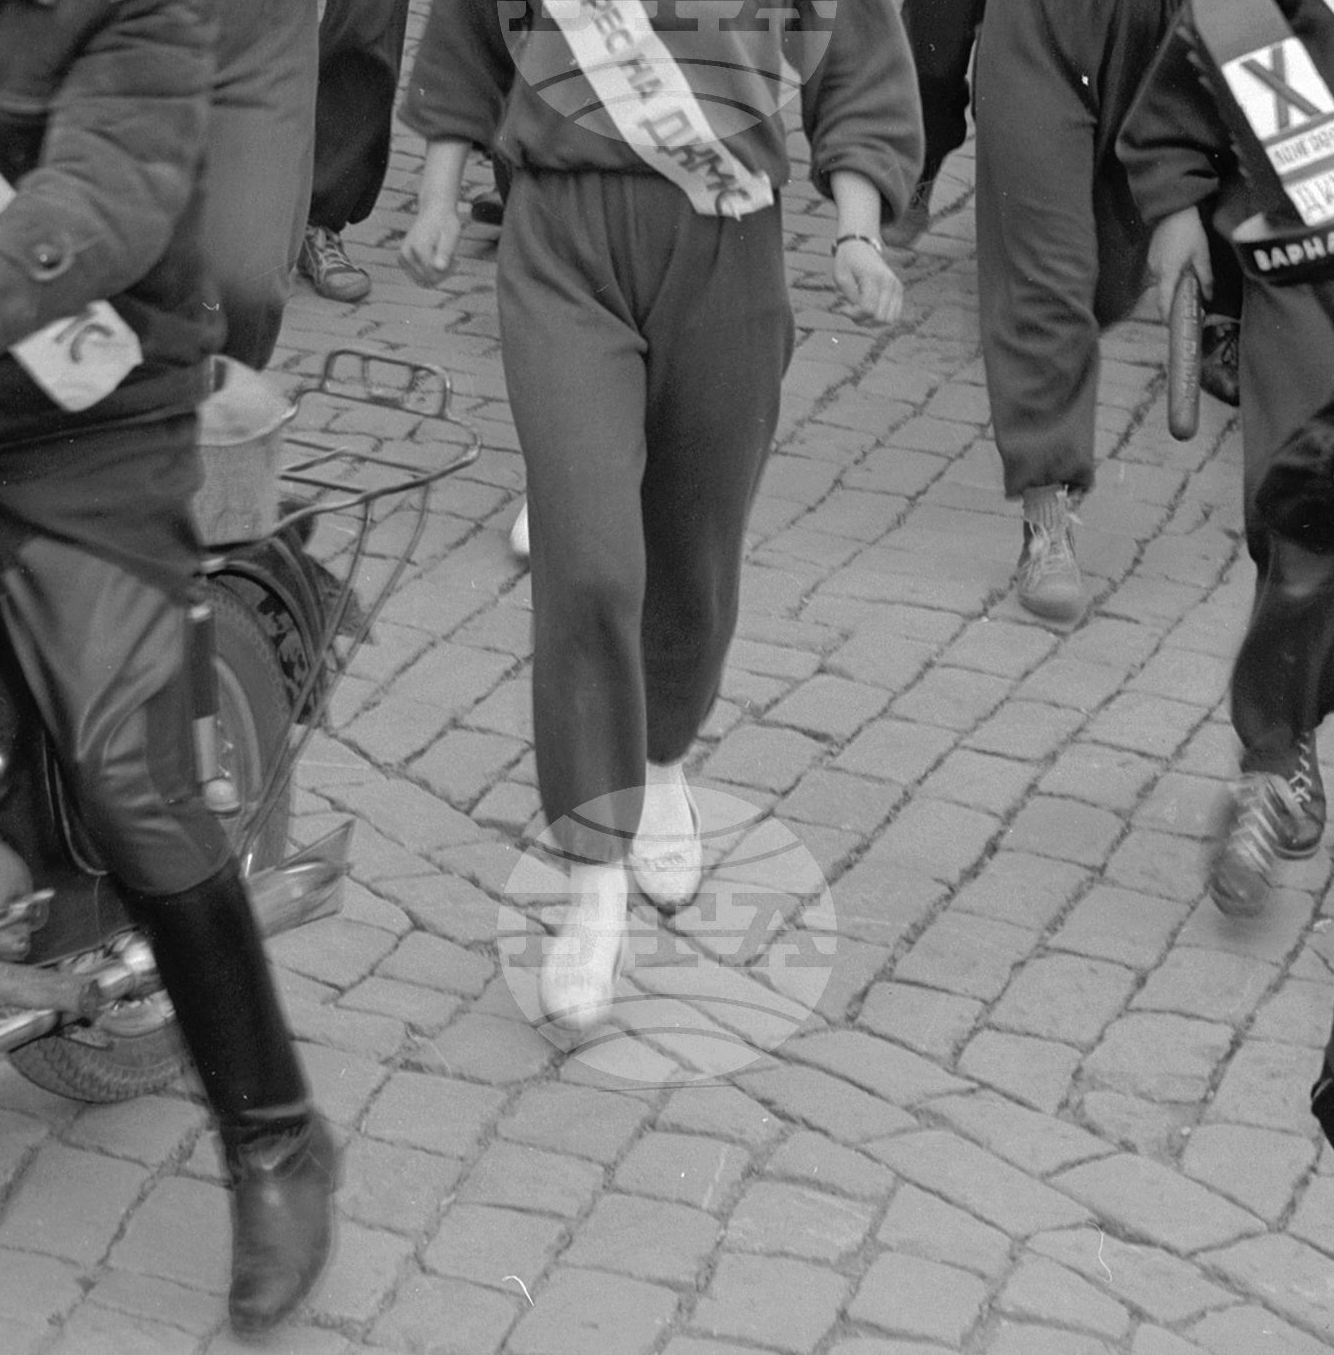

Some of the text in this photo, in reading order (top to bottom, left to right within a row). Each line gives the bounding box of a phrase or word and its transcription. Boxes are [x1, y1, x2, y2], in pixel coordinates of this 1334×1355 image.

[616, 52, 665, 107] НА
[1239, 46, 1321, 132] X
[637, 108, 754, 218] ДКМС
